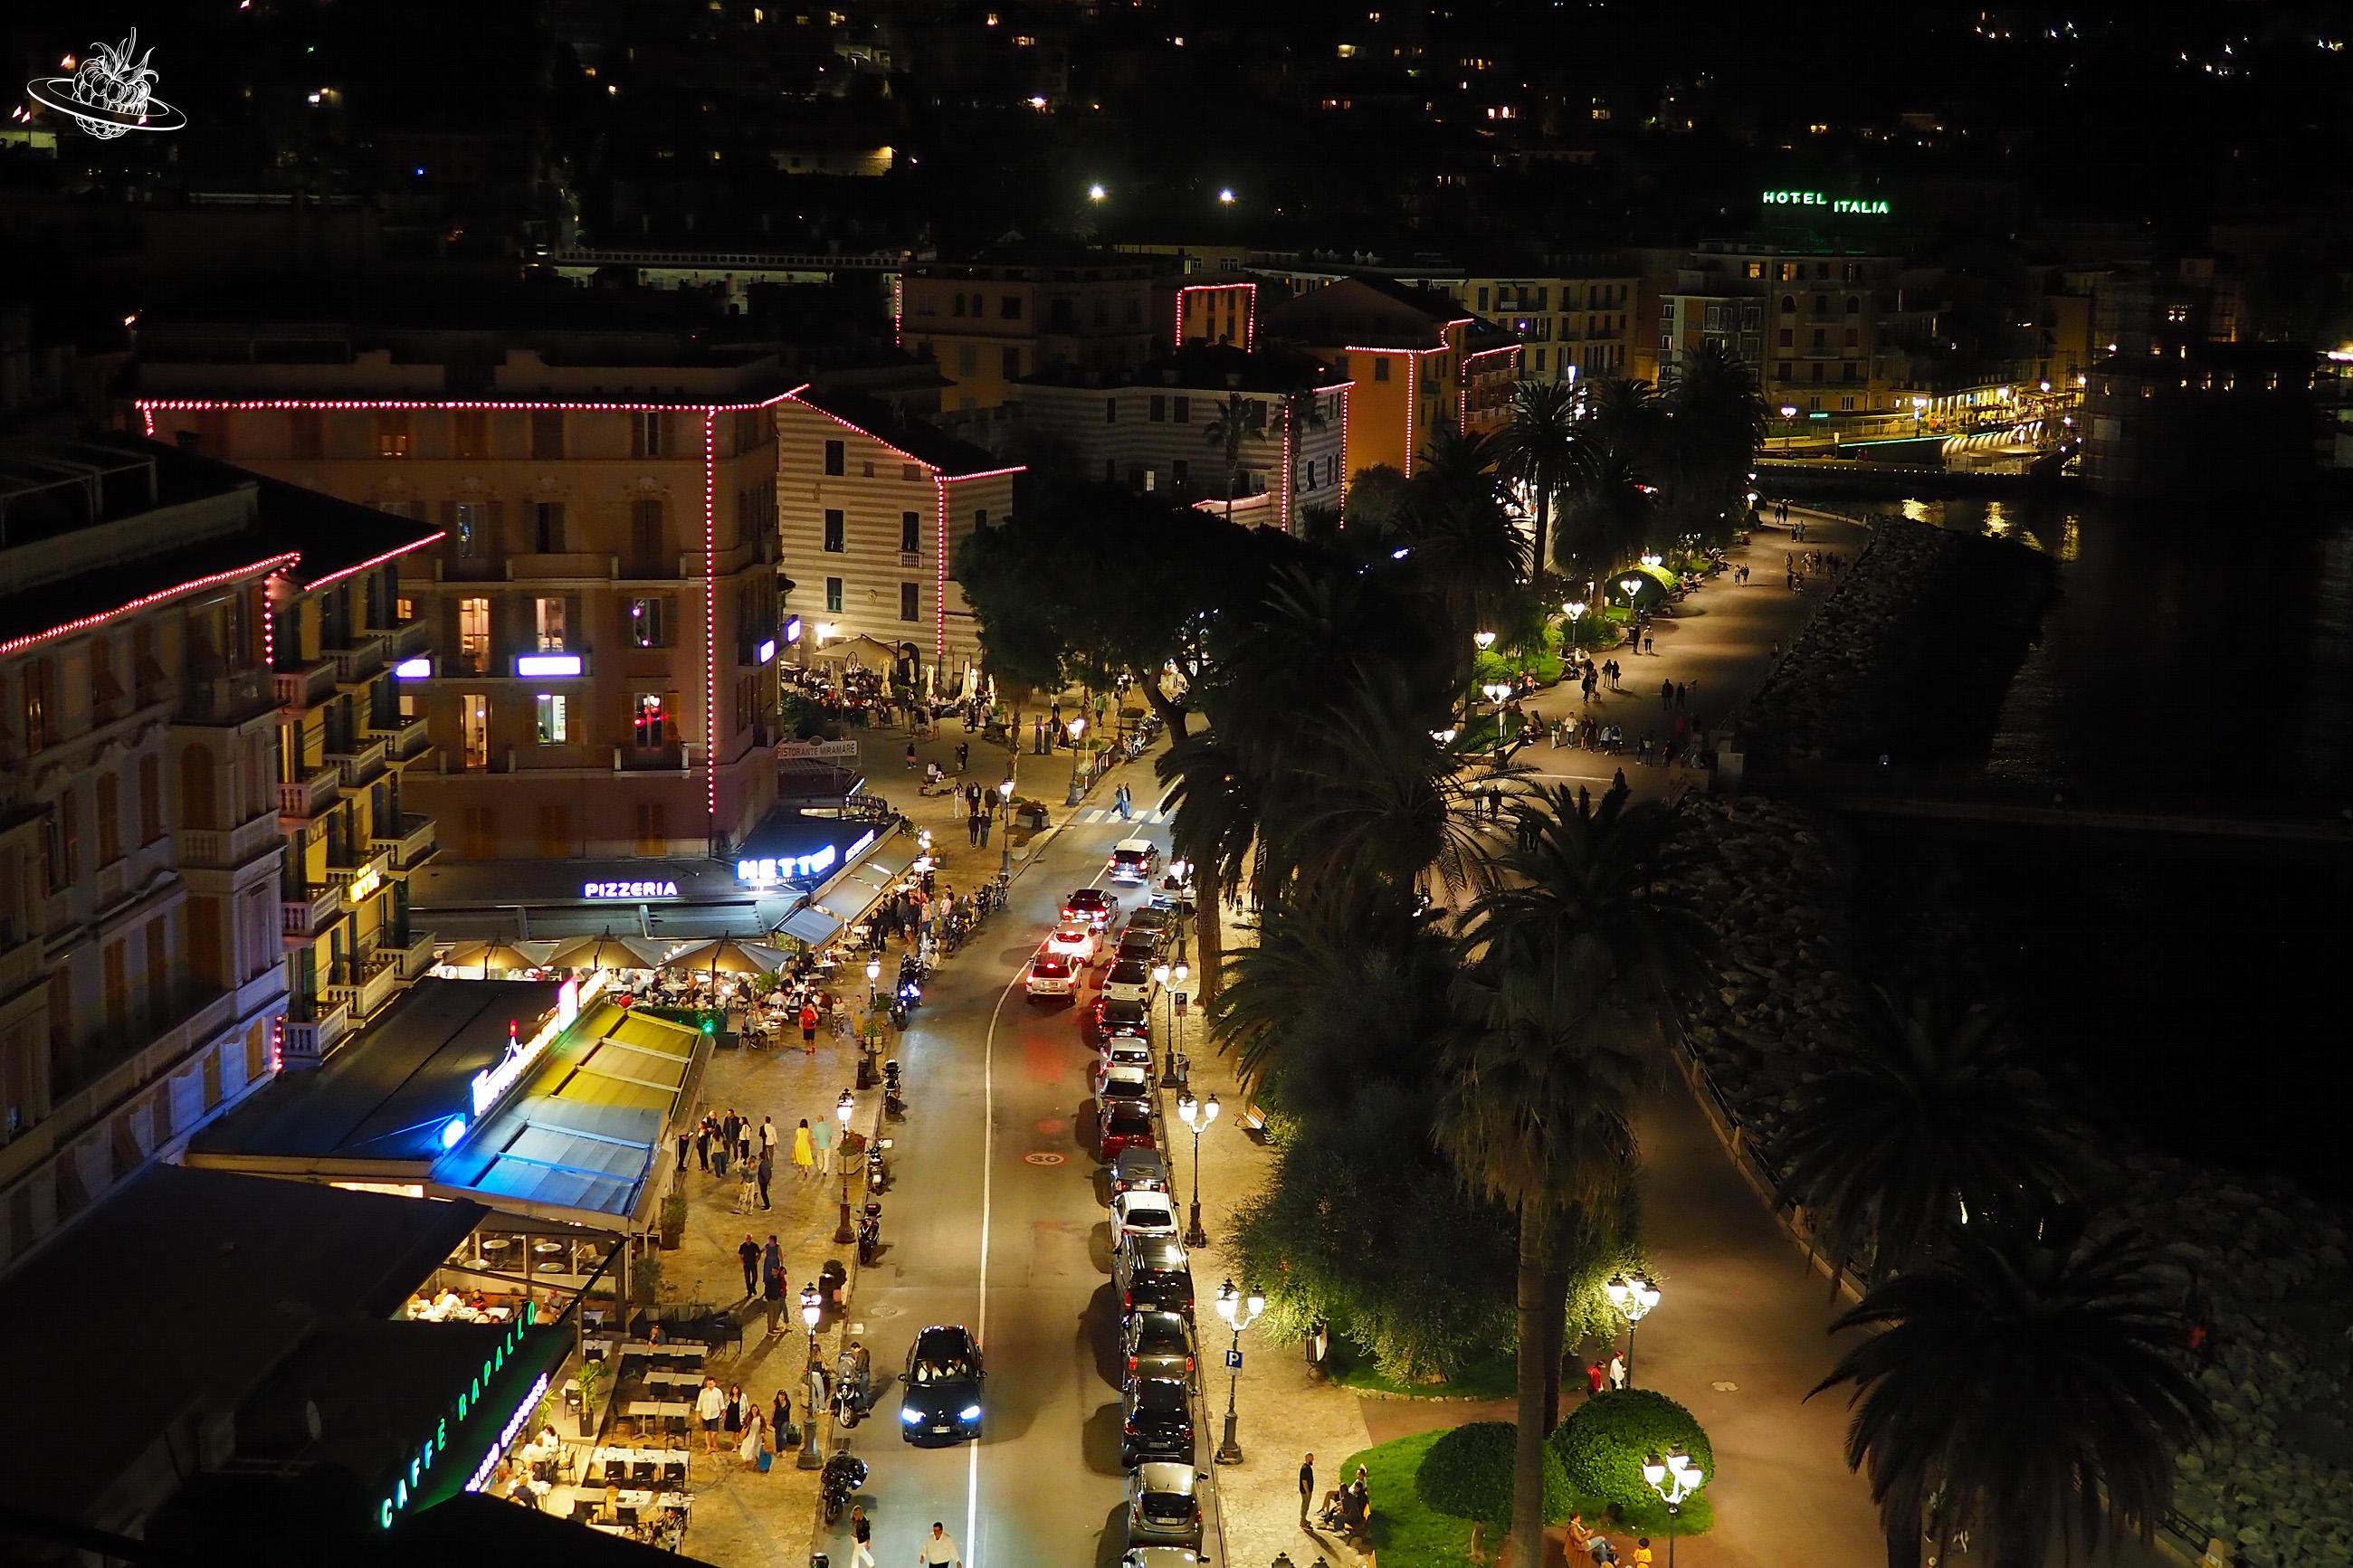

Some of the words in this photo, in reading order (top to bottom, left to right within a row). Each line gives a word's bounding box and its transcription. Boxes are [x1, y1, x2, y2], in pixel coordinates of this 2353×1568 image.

[1763, 191, 1827, 204] HOTEL
[1834, 201, 1890, 214] ITALIA
[777, 746, 819, 757] RISTORANTE
[820, 743, 855, 755] MIRAMARE
[584, 881, 678, 898] PIZZERIA
[1176, 993, 1185, 1004] P
[458, 1300, 536, 1421] RAPALLO
[1228, 1351, 1240, 1365] P
